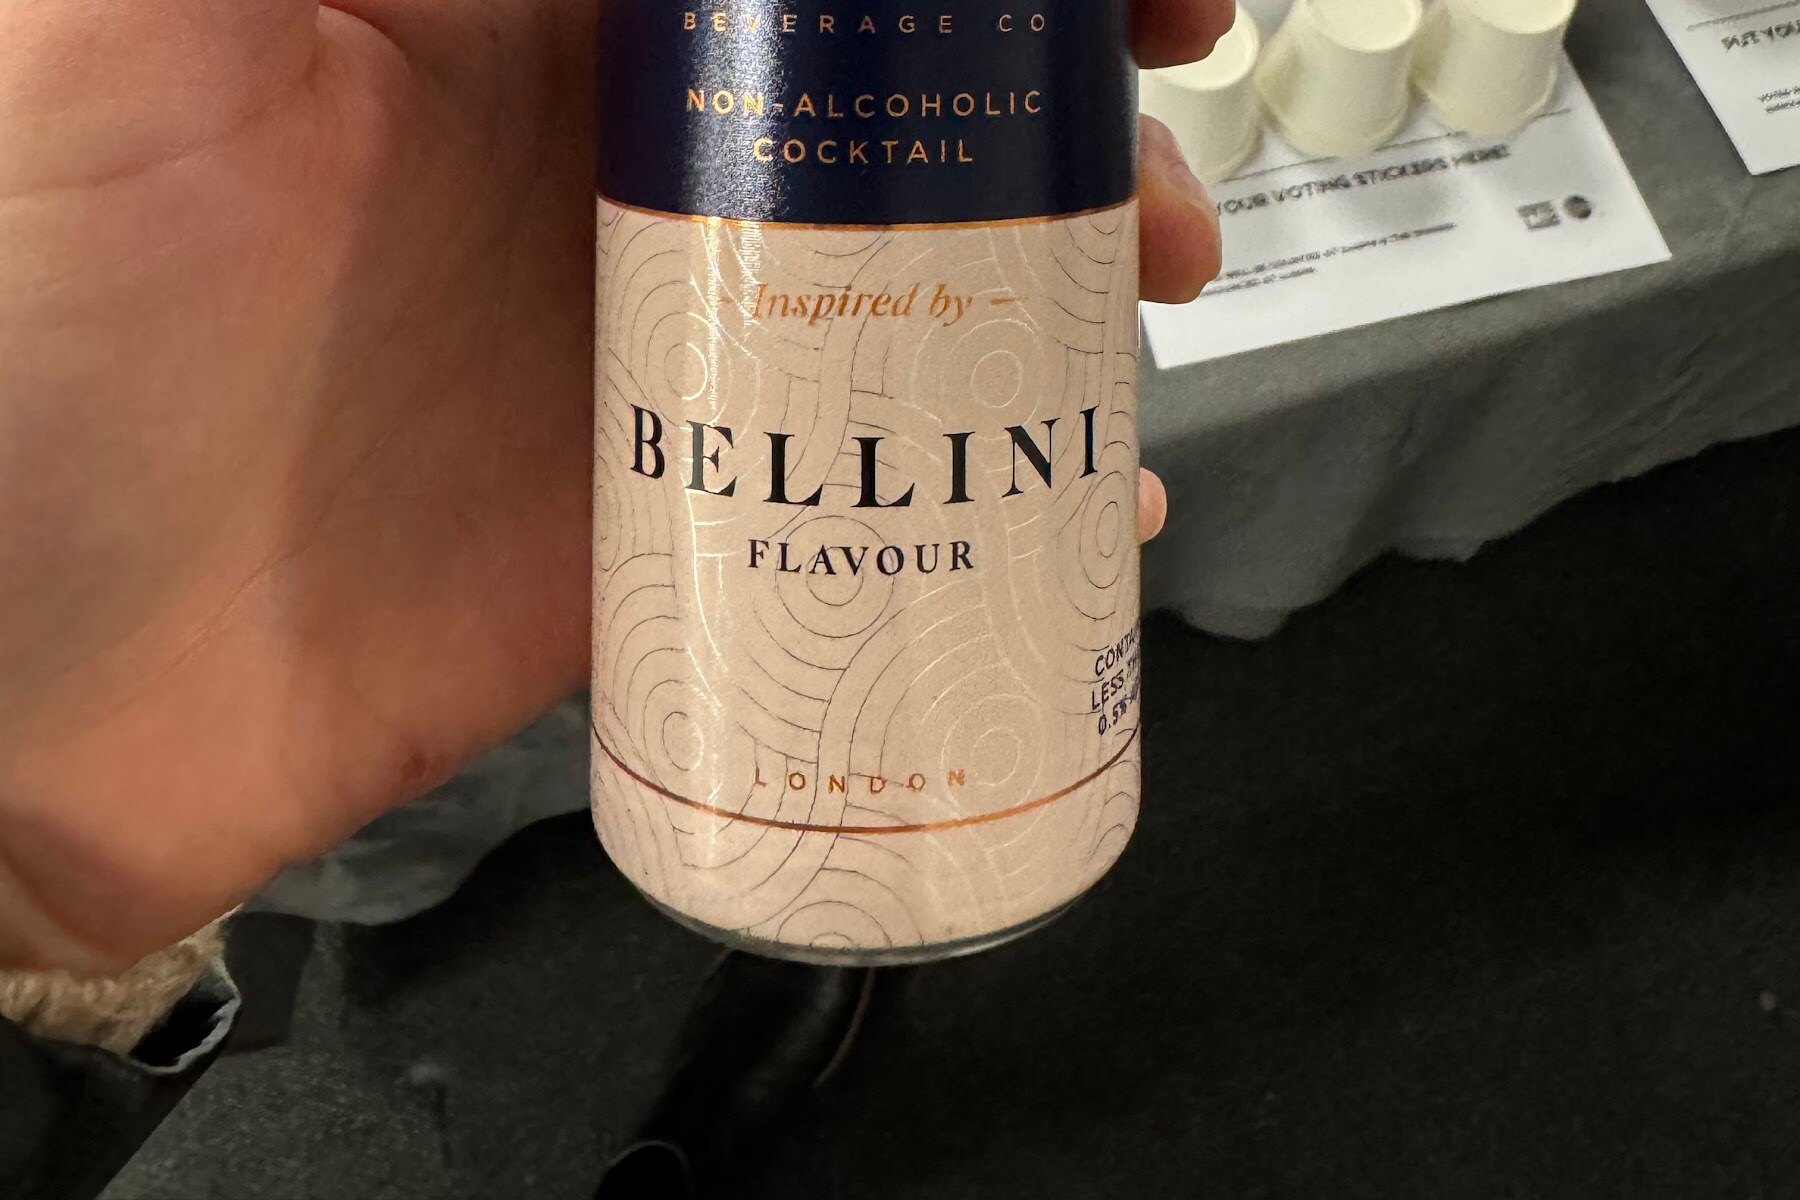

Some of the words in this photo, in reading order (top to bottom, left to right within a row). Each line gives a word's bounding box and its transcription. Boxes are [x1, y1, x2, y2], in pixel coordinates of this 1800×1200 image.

[683, 11, 954, 35] BEVERAGE
[998, 12, 1046, 34] CO
[685, 88, 1042, 119] NON-ALCOHOLIC
[753, 136, 973, 164] COCKTAIL
[1270, 173, 1350, 205] VOTING
[1352, 156, 1449, 187] STICKERS
[755, 282, 921, 327] Inspired
[928, 283, 974, 327] by
[630, 403, 1099, 508] BELLINI
[748, 538, 975, 577] FLAVOUR
[1091, 668, 1125, 711] LESS
[755, 767, 966, 795] LONDON
